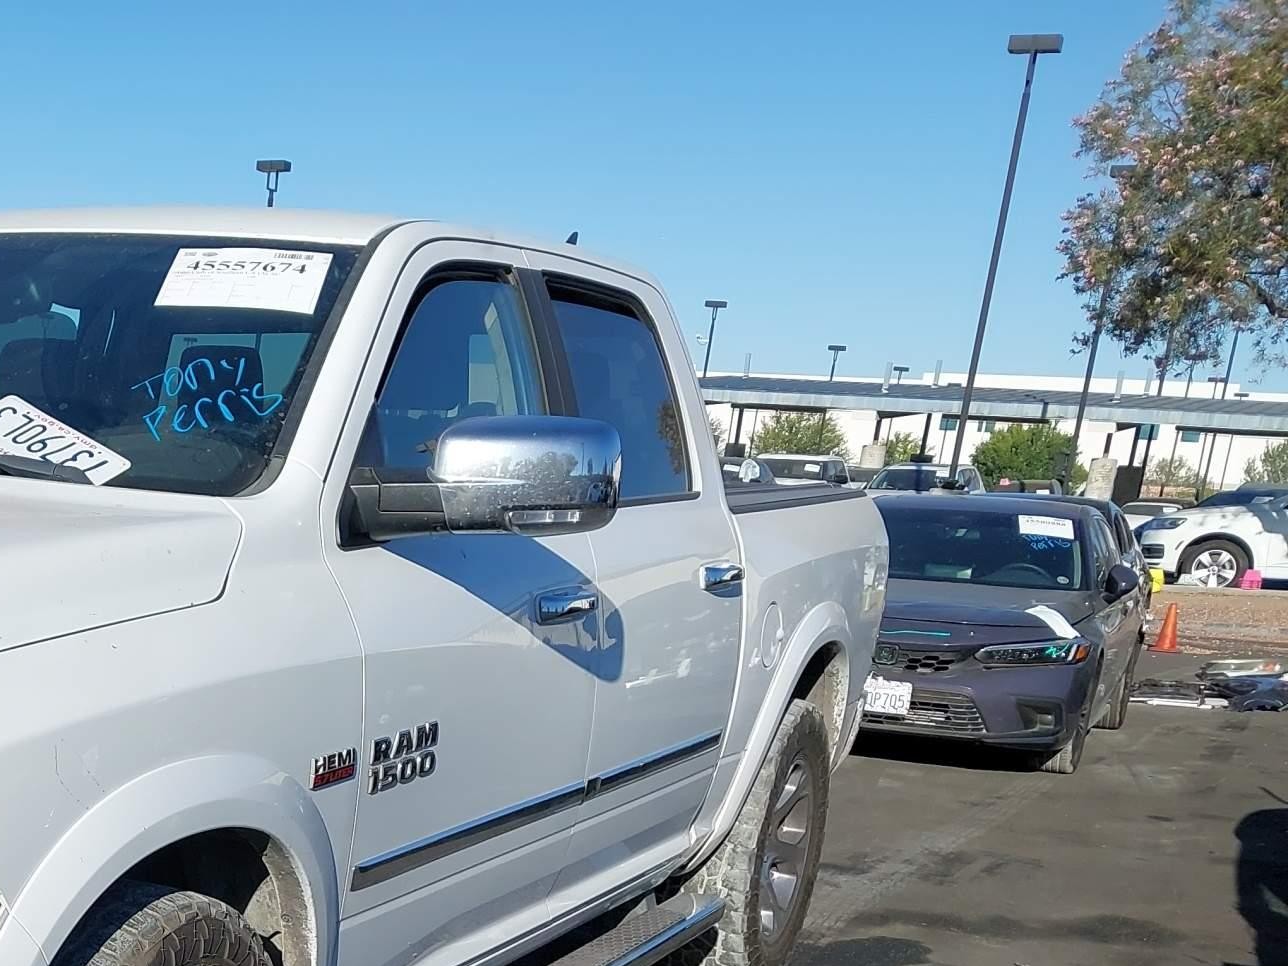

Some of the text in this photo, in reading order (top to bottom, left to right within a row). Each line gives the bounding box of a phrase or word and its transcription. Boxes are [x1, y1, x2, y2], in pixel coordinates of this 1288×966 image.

[185, 260, 307, 274] 45557674
[310, 747, 357, 775] HEMI
[369, 720, 440, 766] RAM
[367, 750, 437, 795] 1500
